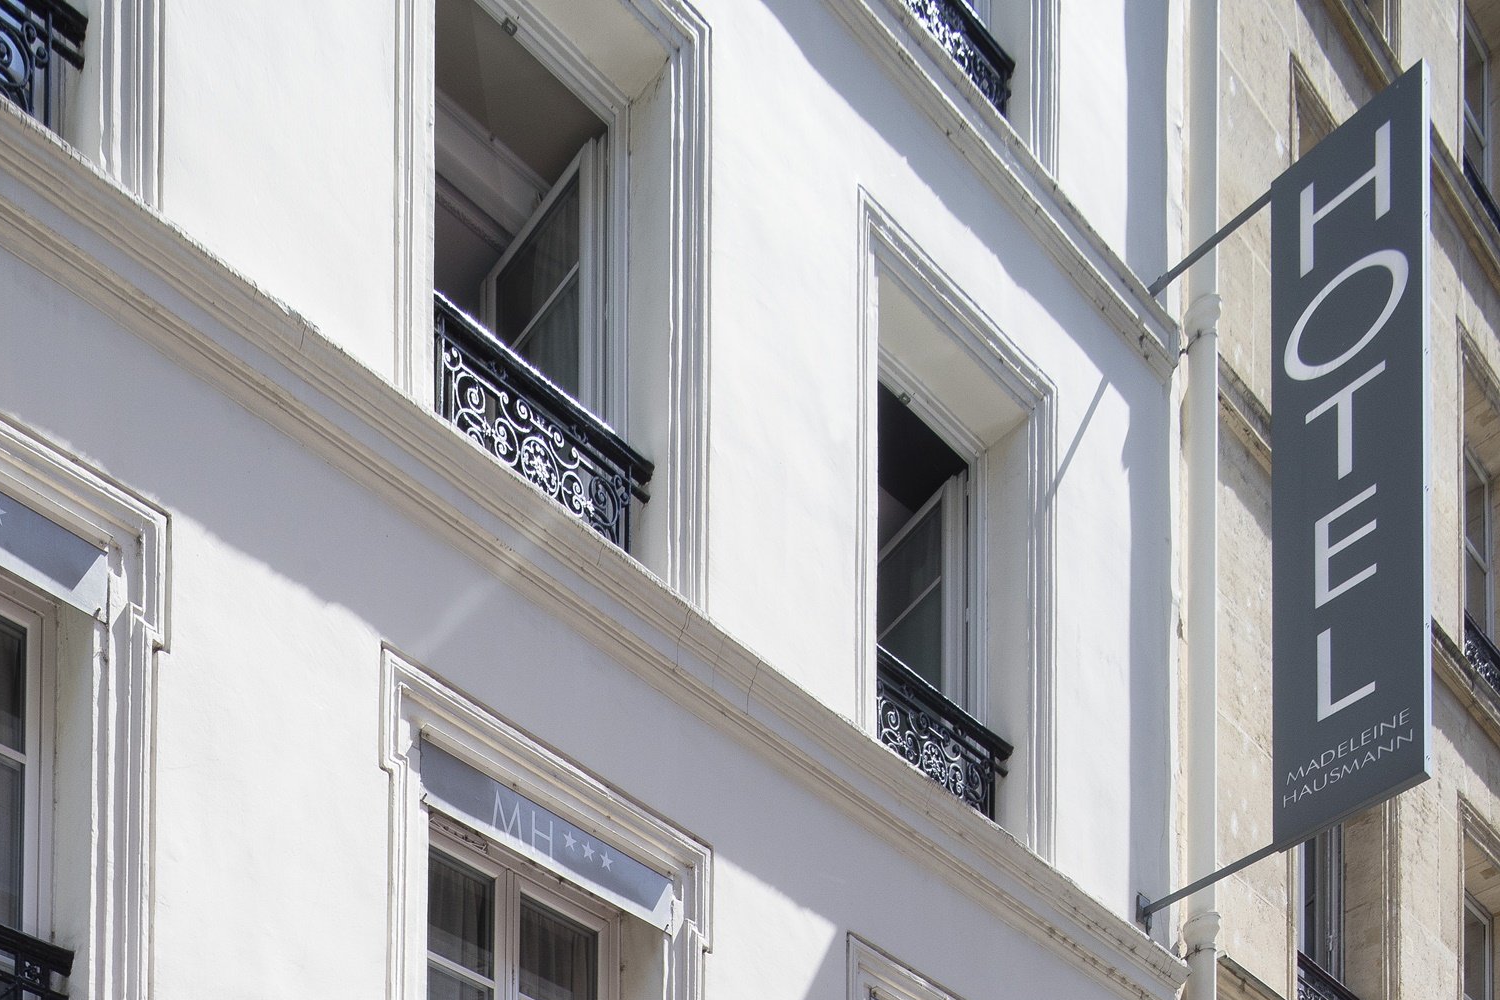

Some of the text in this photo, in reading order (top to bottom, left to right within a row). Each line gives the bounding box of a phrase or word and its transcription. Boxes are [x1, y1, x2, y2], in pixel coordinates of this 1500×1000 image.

[1284, 120, 1408, 723] HOTEL
[1283, 729, 1413, 808] HAUSMANN
[1286, 707, 1410, 785] MADELEINE
